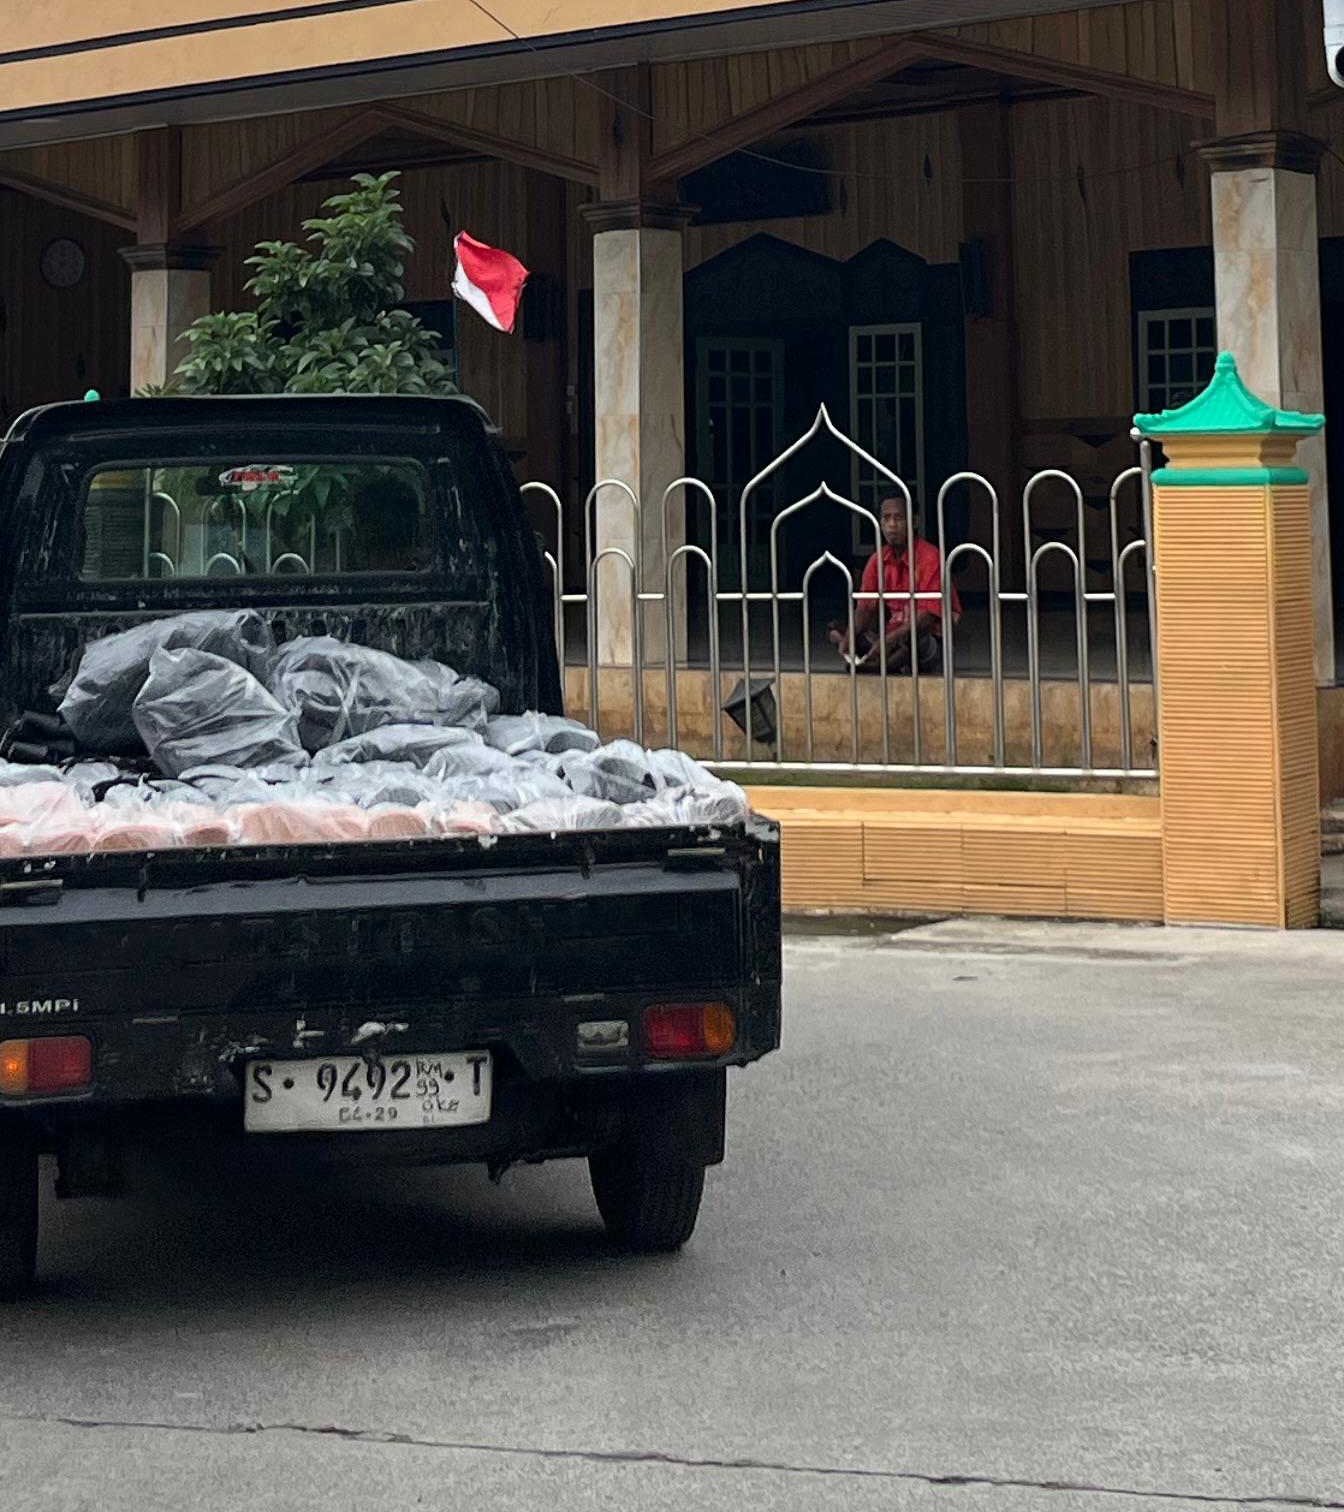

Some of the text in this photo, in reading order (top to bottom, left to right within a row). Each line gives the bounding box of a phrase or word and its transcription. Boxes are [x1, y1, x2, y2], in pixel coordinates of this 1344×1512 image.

[252, 1055, 488, 1104] S 9492 T
